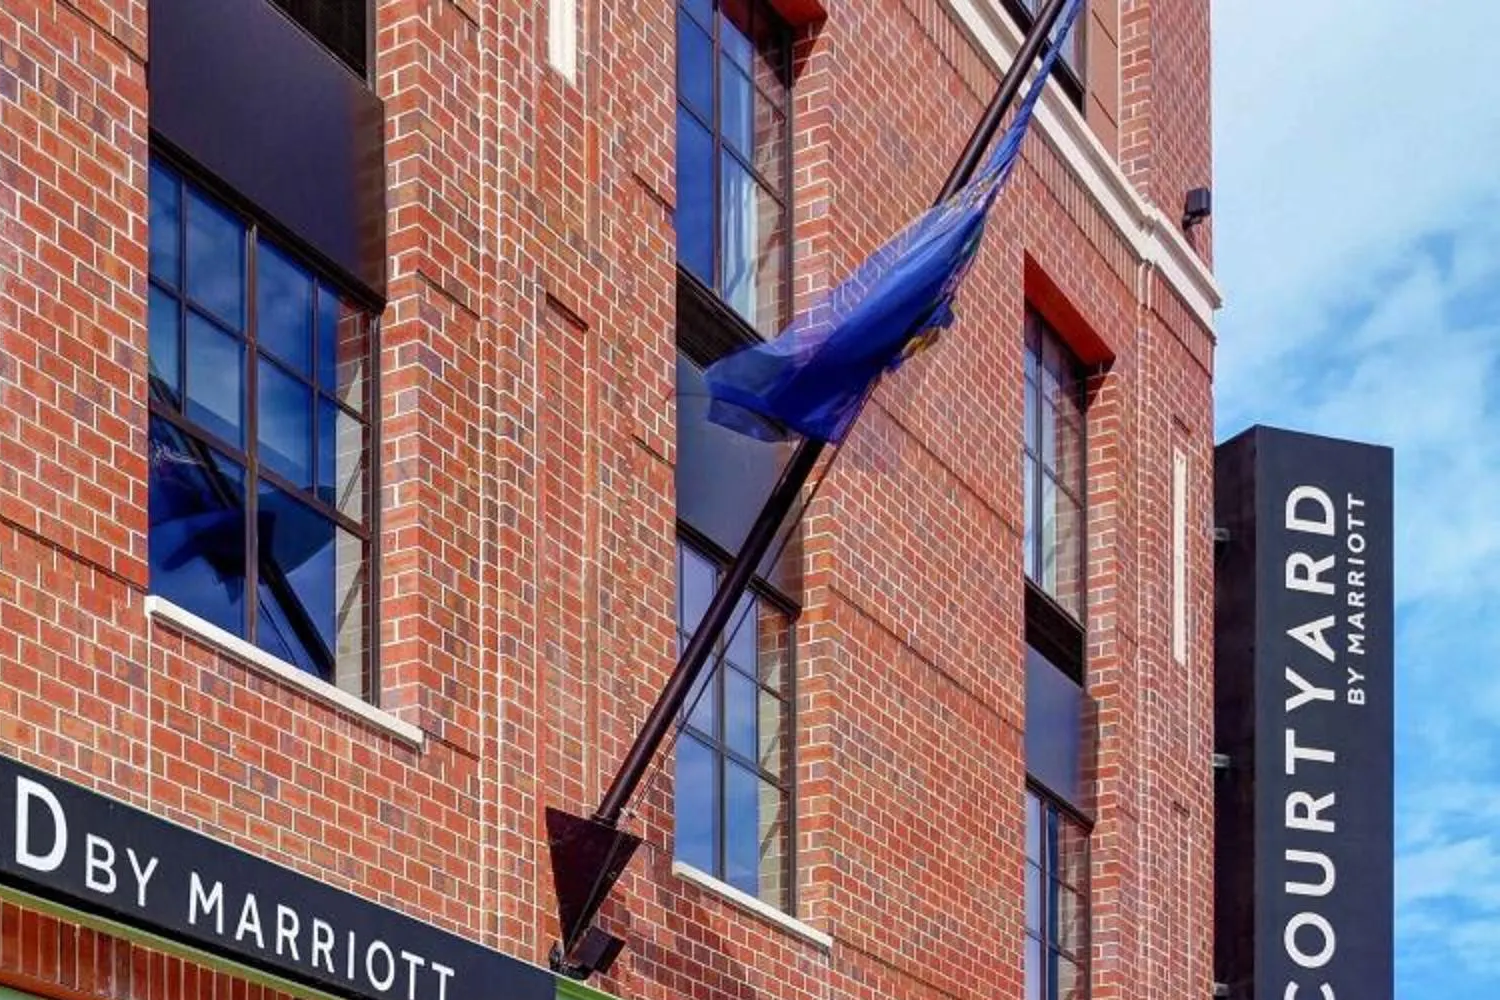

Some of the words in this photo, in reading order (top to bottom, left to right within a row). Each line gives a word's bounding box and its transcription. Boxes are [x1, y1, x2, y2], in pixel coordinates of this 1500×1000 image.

[1347, 492, 1366, 655] MARRIOTT
[1347, 666, 1366, 705] BY
[85, 832, 160, 907] BY
